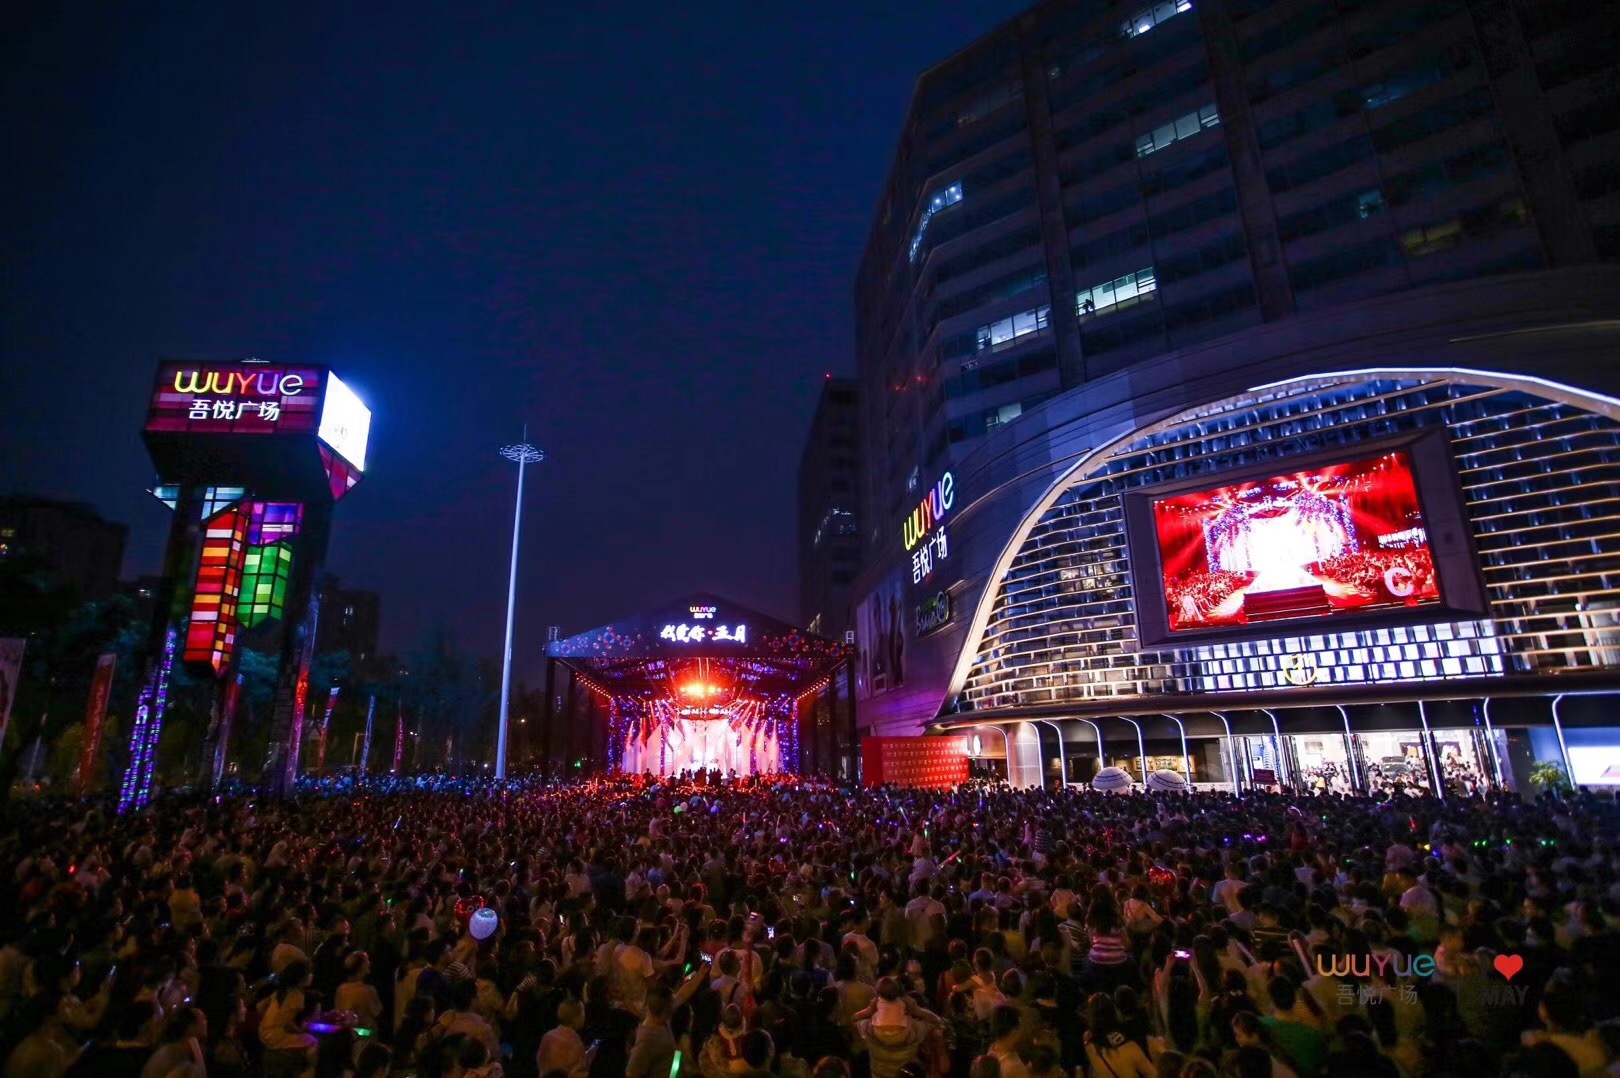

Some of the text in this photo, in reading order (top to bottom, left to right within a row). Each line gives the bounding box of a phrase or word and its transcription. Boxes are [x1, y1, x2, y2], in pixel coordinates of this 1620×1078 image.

[188, 399, 281, 422] 吾悦广场
[912, 525, 948, 584] 吾悦广场
